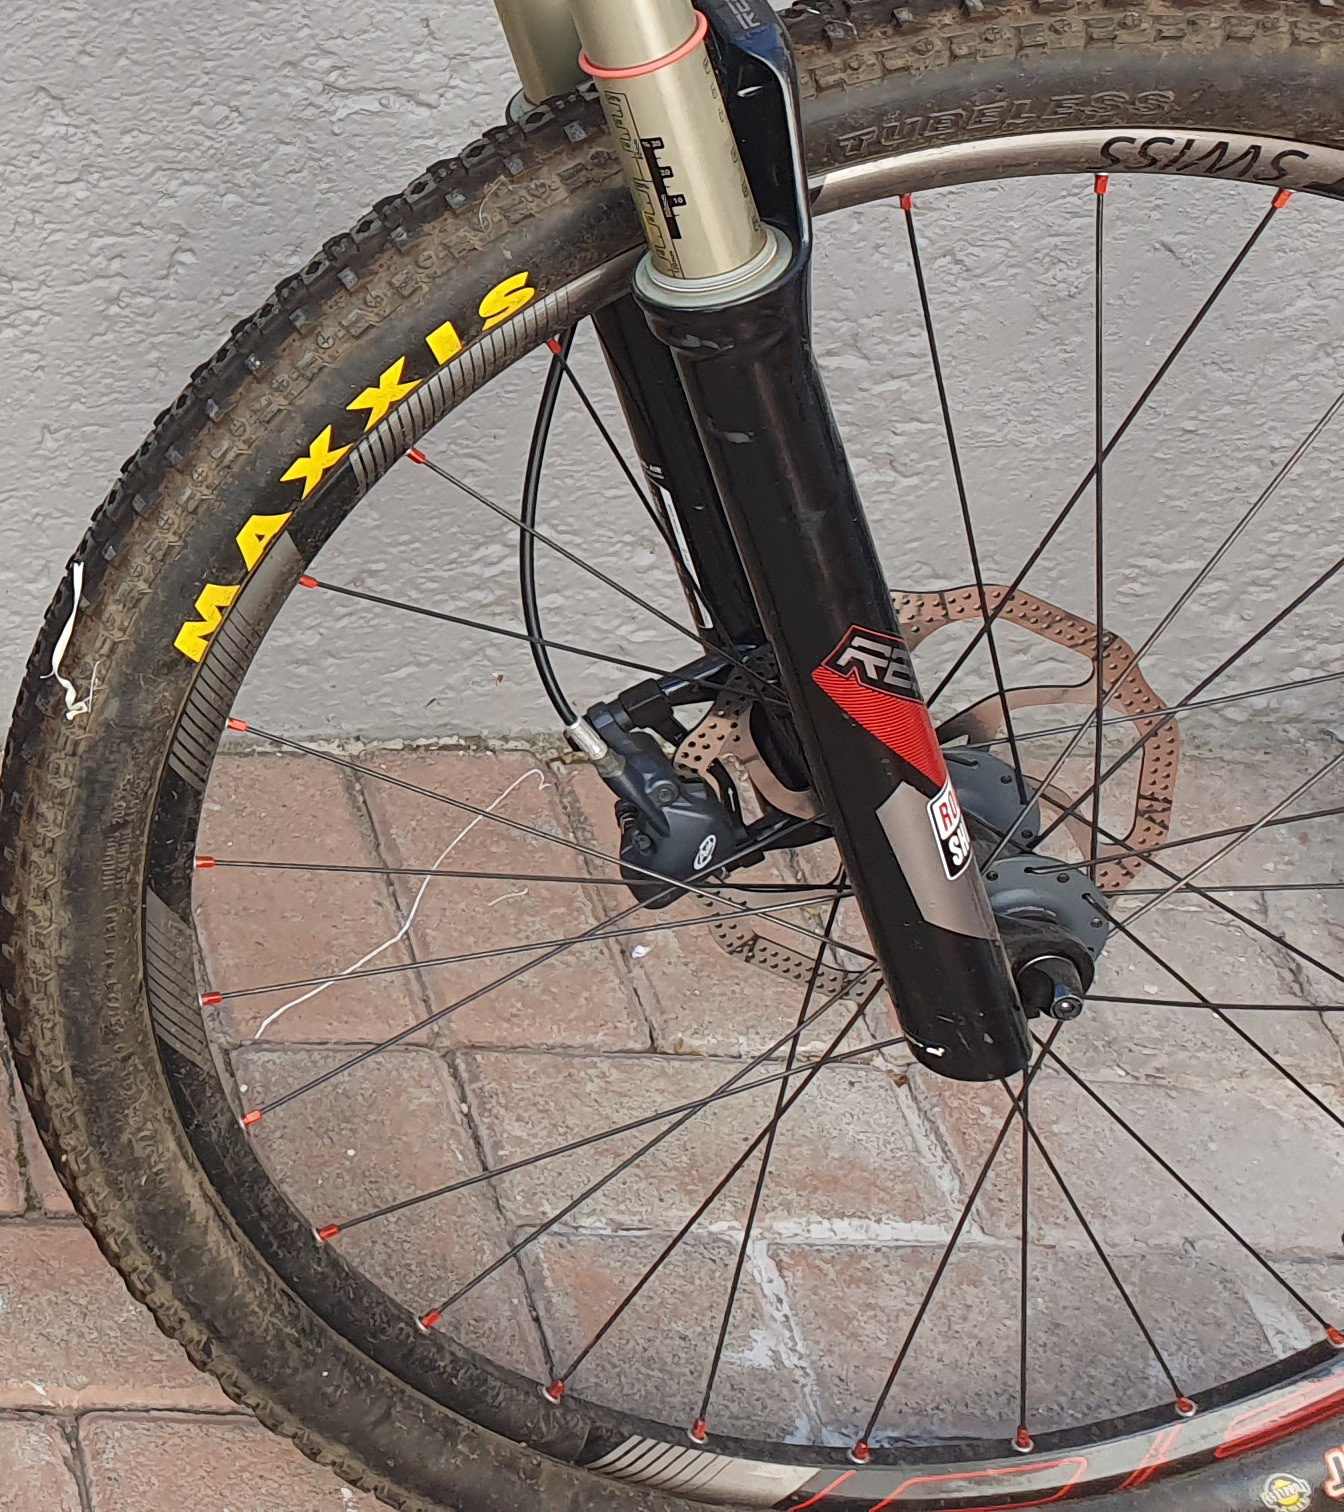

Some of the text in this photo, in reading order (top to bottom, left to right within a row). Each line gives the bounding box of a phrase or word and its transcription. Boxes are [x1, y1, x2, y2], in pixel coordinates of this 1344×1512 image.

[838, 90, 1178, 157] TUBELESS
[1086, 136, 1310, 183] SWISS
[173, 271, 535, 663] MAXXIS
